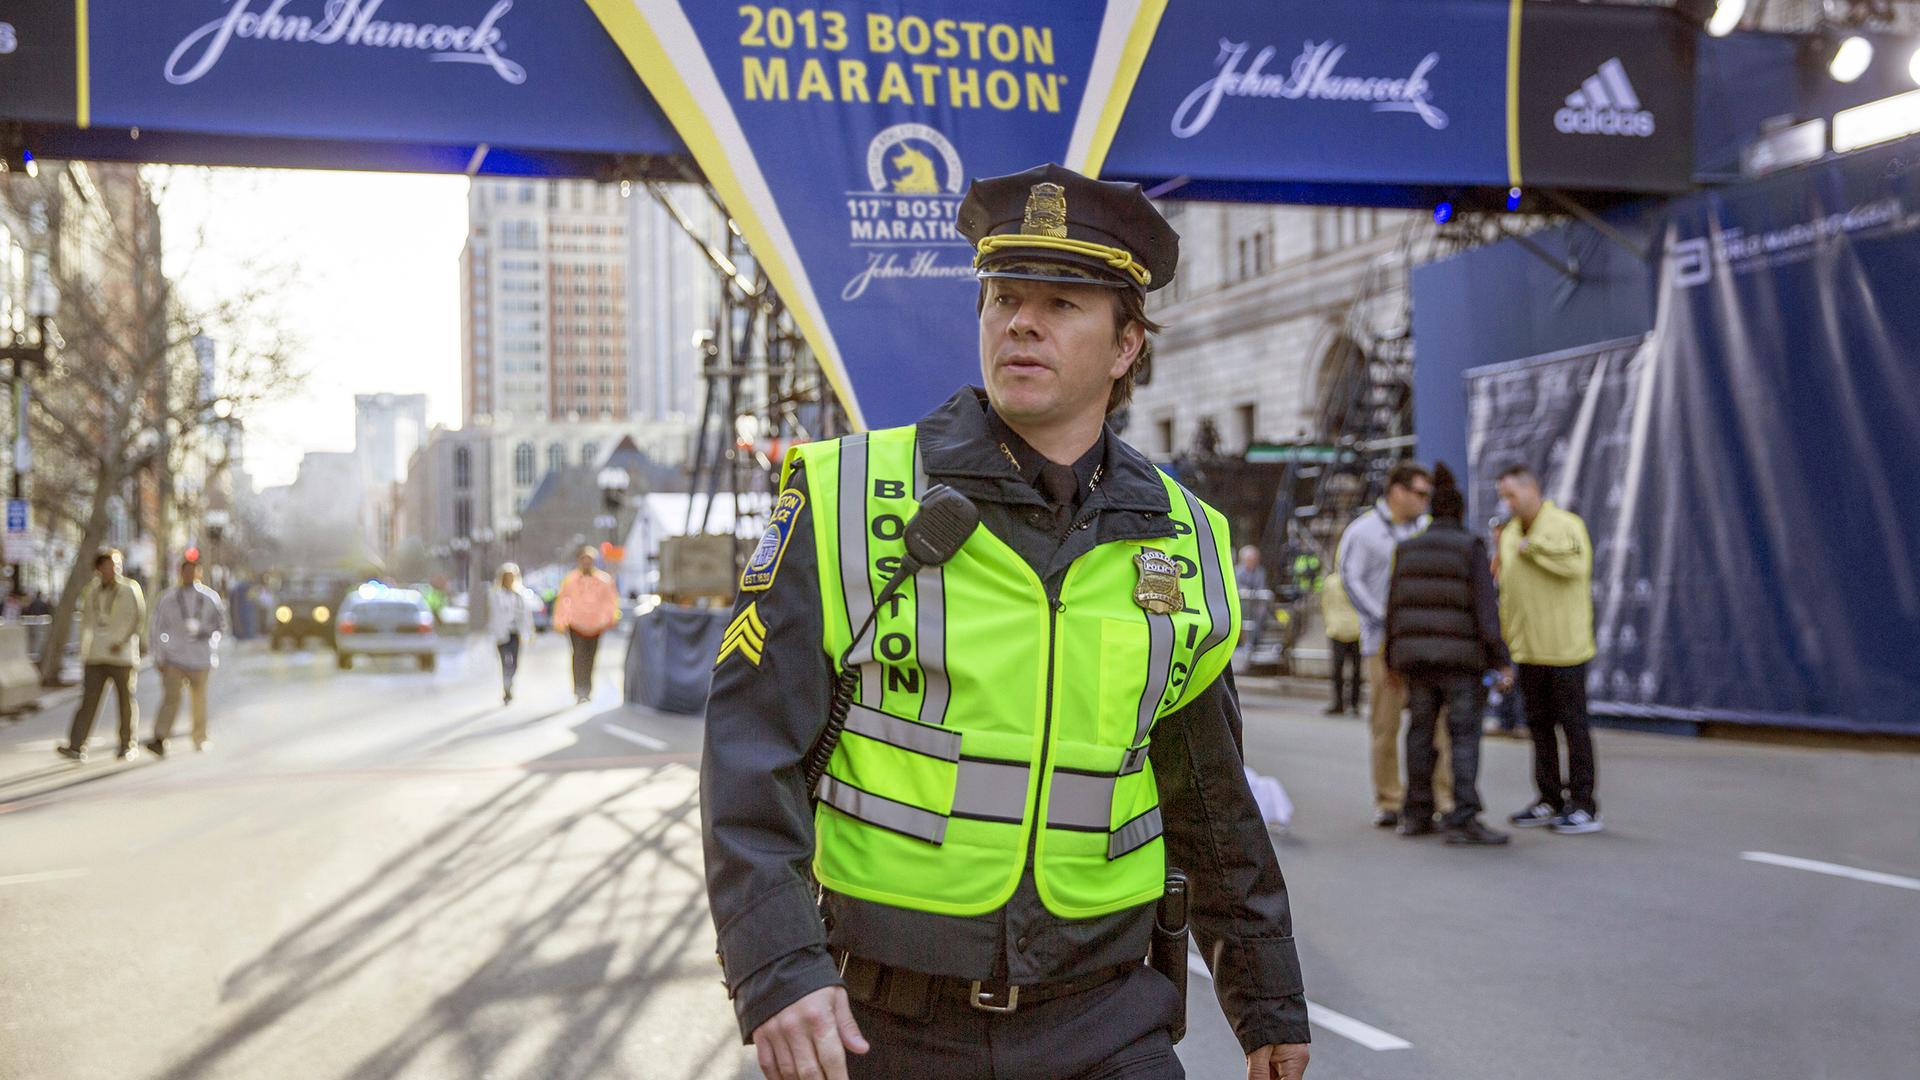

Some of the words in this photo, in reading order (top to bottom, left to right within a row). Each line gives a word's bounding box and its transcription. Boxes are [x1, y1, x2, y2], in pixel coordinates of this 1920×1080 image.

[738, 5, 849, 52] 2013
[866, 12, 1055, 65] BOSTON
[1170, 36, 1284, 139] John
[1281, 38, 1449, 130] Hancock
[1553, 106, 1656, 138] adidas
[896, 200, 960, 219] BOST
[851, 219, 968, 241] MARATH
[841, 251, 906, 301] John
[1144, 562, 1177, 576] POLICE
